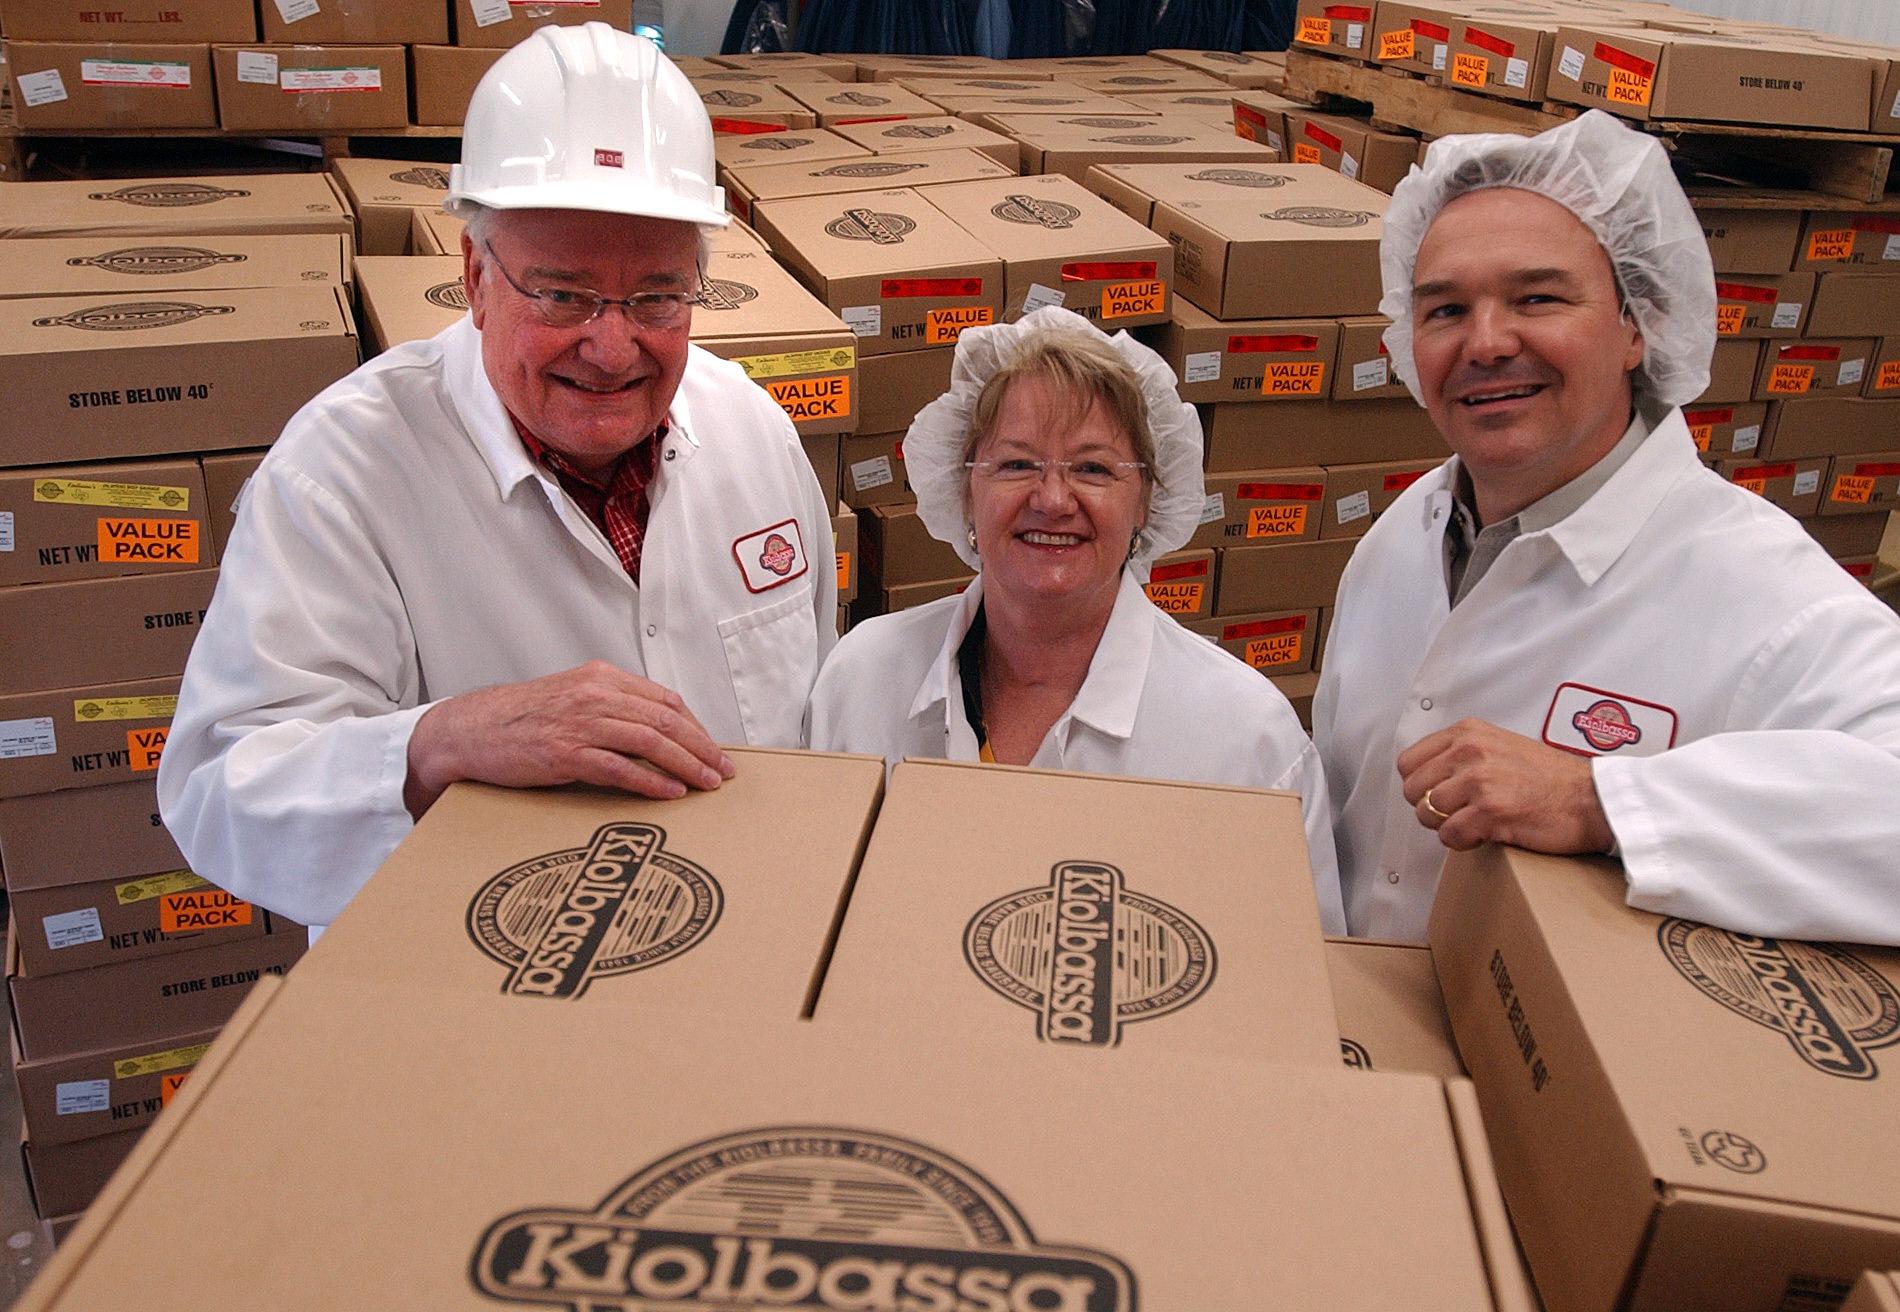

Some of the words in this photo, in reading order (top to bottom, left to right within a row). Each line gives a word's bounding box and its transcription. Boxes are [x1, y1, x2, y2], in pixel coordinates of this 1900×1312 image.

[80, 12, 100, 23] NET
[1303, 18, 1328, 31] VALUE
[1304, 32, 1325, 43] PACK
[1383, 31, 1412, 45] VALUE
[1385, 44, 1409, 57] PACK
[1456, 56, 1486, 71] VALUE
[1457, 70, 1481, 84] PACK
[1613, 71, 1649, 88] VALUE
[1739, 76, 1763, 89] STORE
[1765, 79, 1790, 90] BELOW
[1614, 87, 1643, 102] PACK
[1297, 147, 1319, 160] VALUE
[1814, 231, 1852, 244] VALUE
[1814, 245, 1845, 258] PACK
[1108, 283, 1160, 299] VALUE
[1112, 299, 1154, 314] PACK
[1718, 308, 1742, 319] LUE
[933, 309, 989, 325] VALUE
[892, 325, 912, 339] NET
[915, 323, 926, 337] W
[1718, 321, 1734, 332] CK
[1271, 365, 1320, 377] VALUE
[1775, 368, 1811, 379] VALUE
[773, 380, 843, 400] VALUE
[1232, 377, 1252, 389] NET
[1254, 377, 1264, 388] W
[1272, 380, 1313, 391] PACK
[1774, 380, 1803, 390] PACK
[68, 390, 122, 409] STORE
[126, 386, 182, 404] BELOW
[1839, 477, 1871, 489] VALUE
[1838, 489, 1863, 500] PACK
[1255, 507, 1303, 521] VALUE
[106, 522, 191, 539] VALUE
[1224, 524, 1244, 536] NET
[1256, 522, 1296, 534] PACK
[38, 546, 71, 566] NET
[115, 543, 184, 559] PACK
[1151, 585, 1200, 598] VALUE
[144, 611, 194, 630] STORE
[1251, 636, 1298, 652] VALUE
[1254, 650, 1292, 665] PACK
[72, 753, 103, 772] NET
[176, 910, 238, 928] PACK
[514, 830, 654, 997] Kiolbassa
[110, 931, 139, 950] NET
[1050, 869, 1112, 1042] Kiolbassa
[161, 978, 207, 997] STORE
[211, 968, 260, 989] BELOW
[979, 957, 1040, 1001] SAUSAGE
[1727, 931, 1851, 1065] olbassa
[111, 1101, 140, 1120] NET
[505, 1224, 1097, 1312] Kiolbassa
